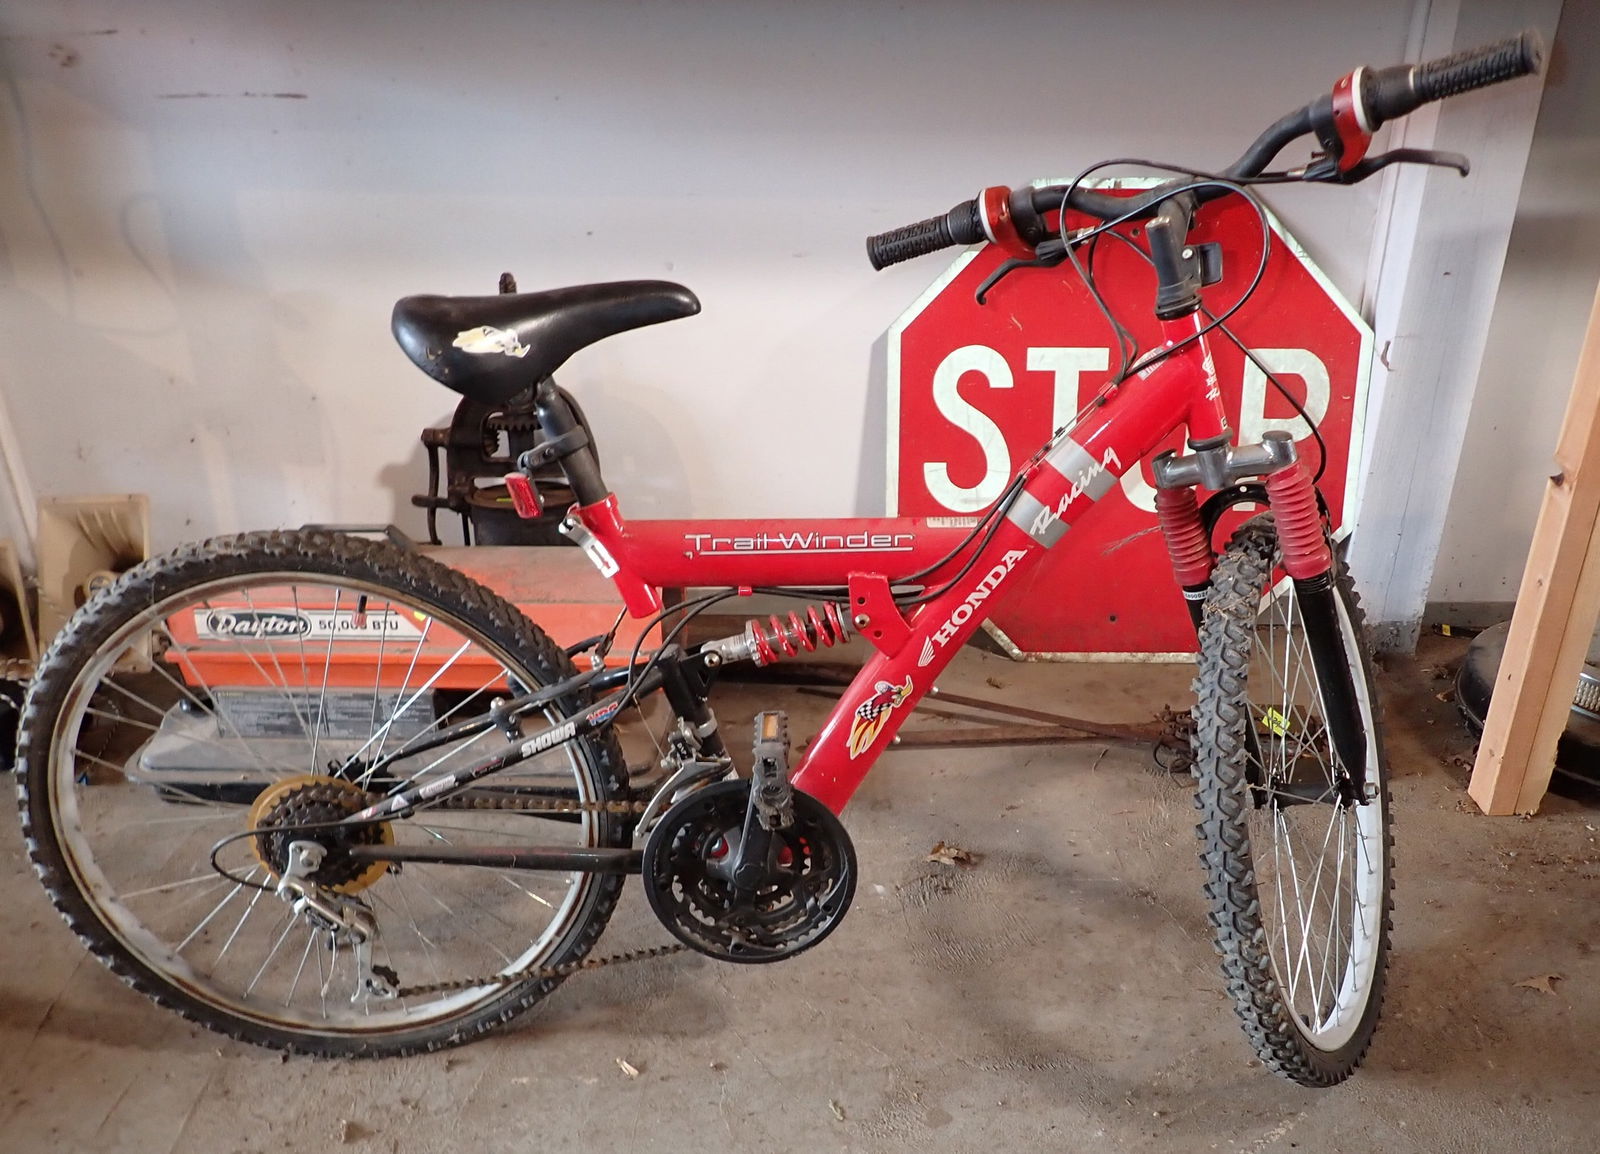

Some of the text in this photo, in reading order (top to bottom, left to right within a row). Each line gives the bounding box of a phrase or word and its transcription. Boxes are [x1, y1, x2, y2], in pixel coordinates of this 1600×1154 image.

[1029, 446, 1122, 535] Racing
[684, 531, 915, 551] Trail Winder
[930, 548, 1028, 648] HONDA
[216, 613, 307, 640] Dayton
[372, 619, 399, 631] BTU
[521, 721, 577, 759] SHOWA
